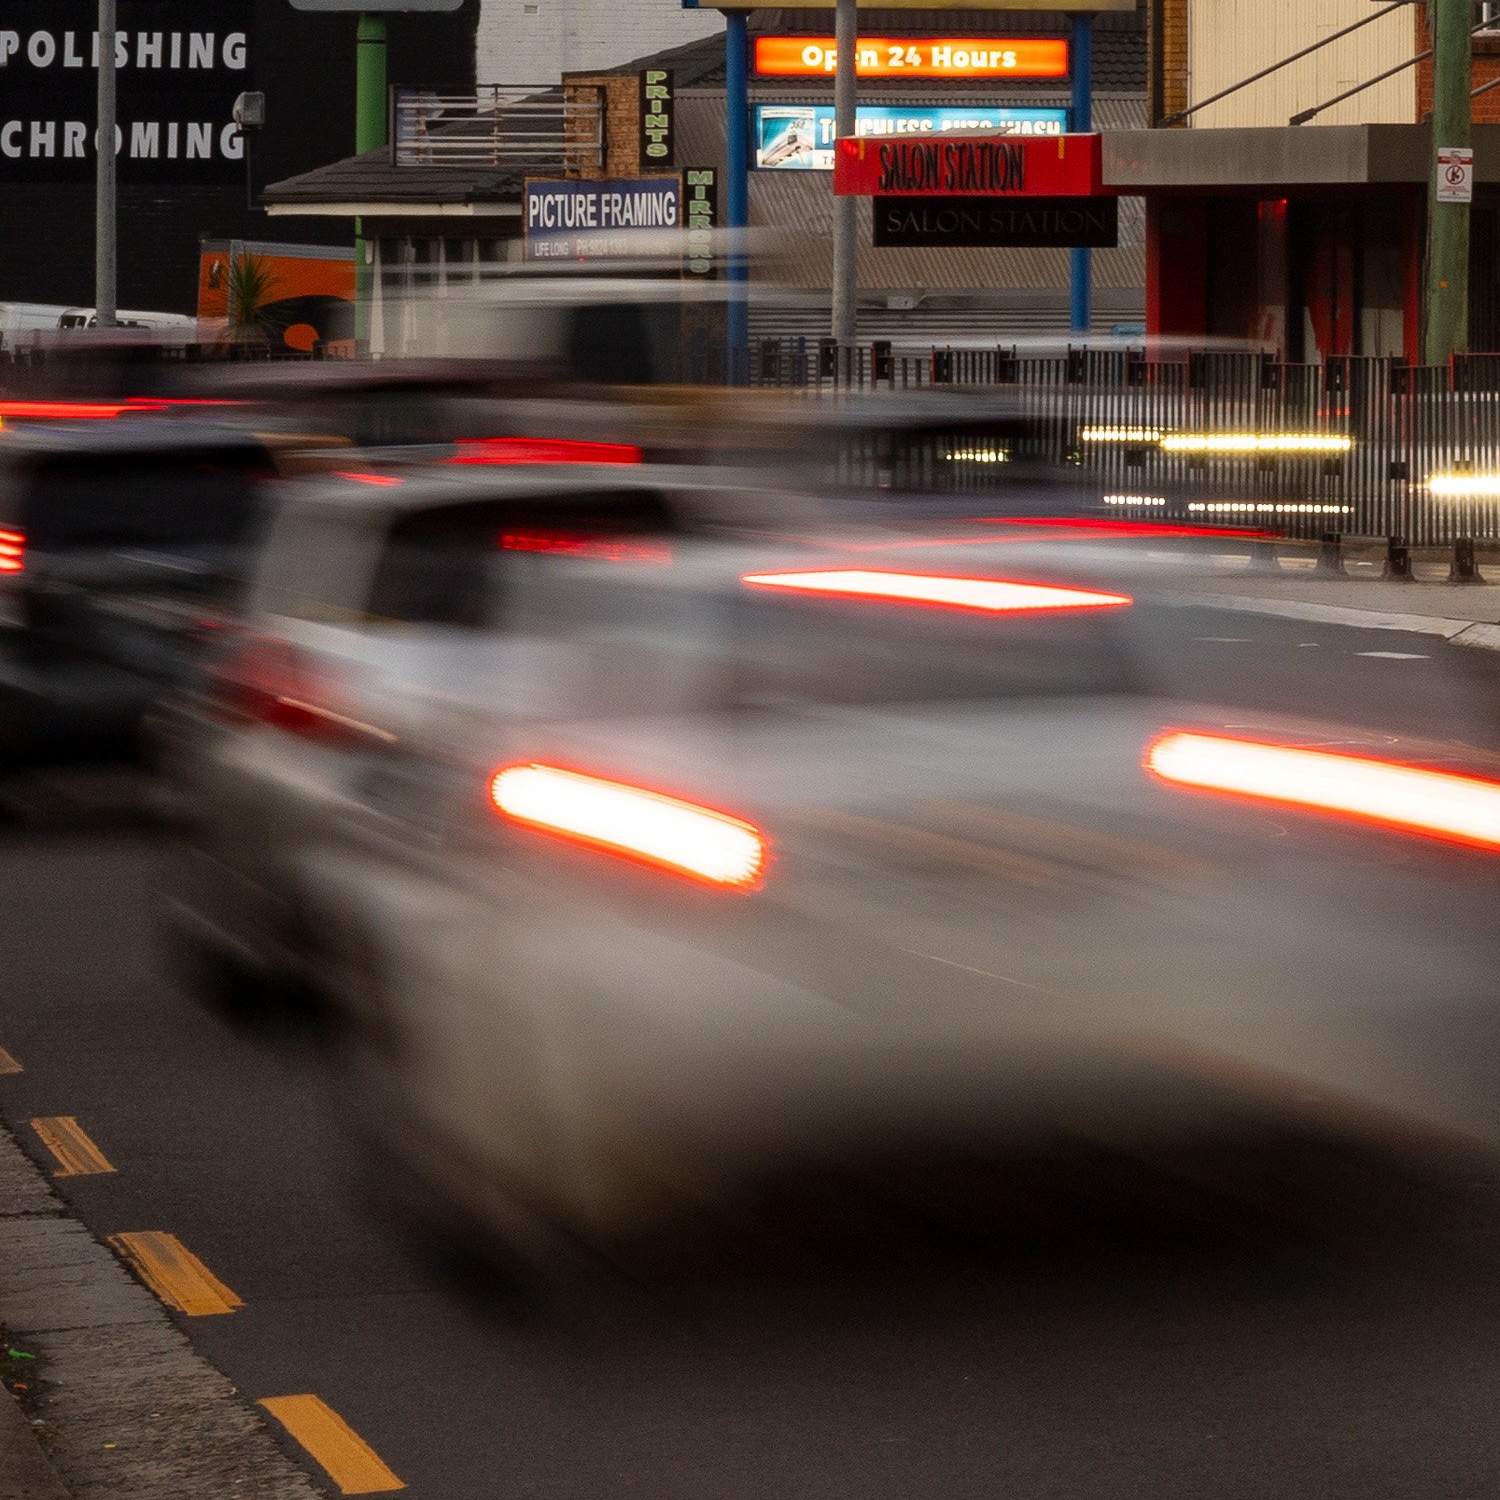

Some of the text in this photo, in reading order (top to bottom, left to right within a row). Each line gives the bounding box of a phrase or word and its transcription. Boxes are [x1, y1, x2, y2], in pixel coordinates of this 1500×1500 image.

[0, 30, 247, 70] POLISHING
[802, 45, 1017, 71] Opn 24 Hours
[645, 70, 671, 158] PRINTS
[878, 143, 1026, 192] SALON STATION
[528, 190, 677, 228] PICTURE FRAMING
[686, 170, 715, 275] MIRRORS
[887, 208, 1103, 234] SALON STATION
